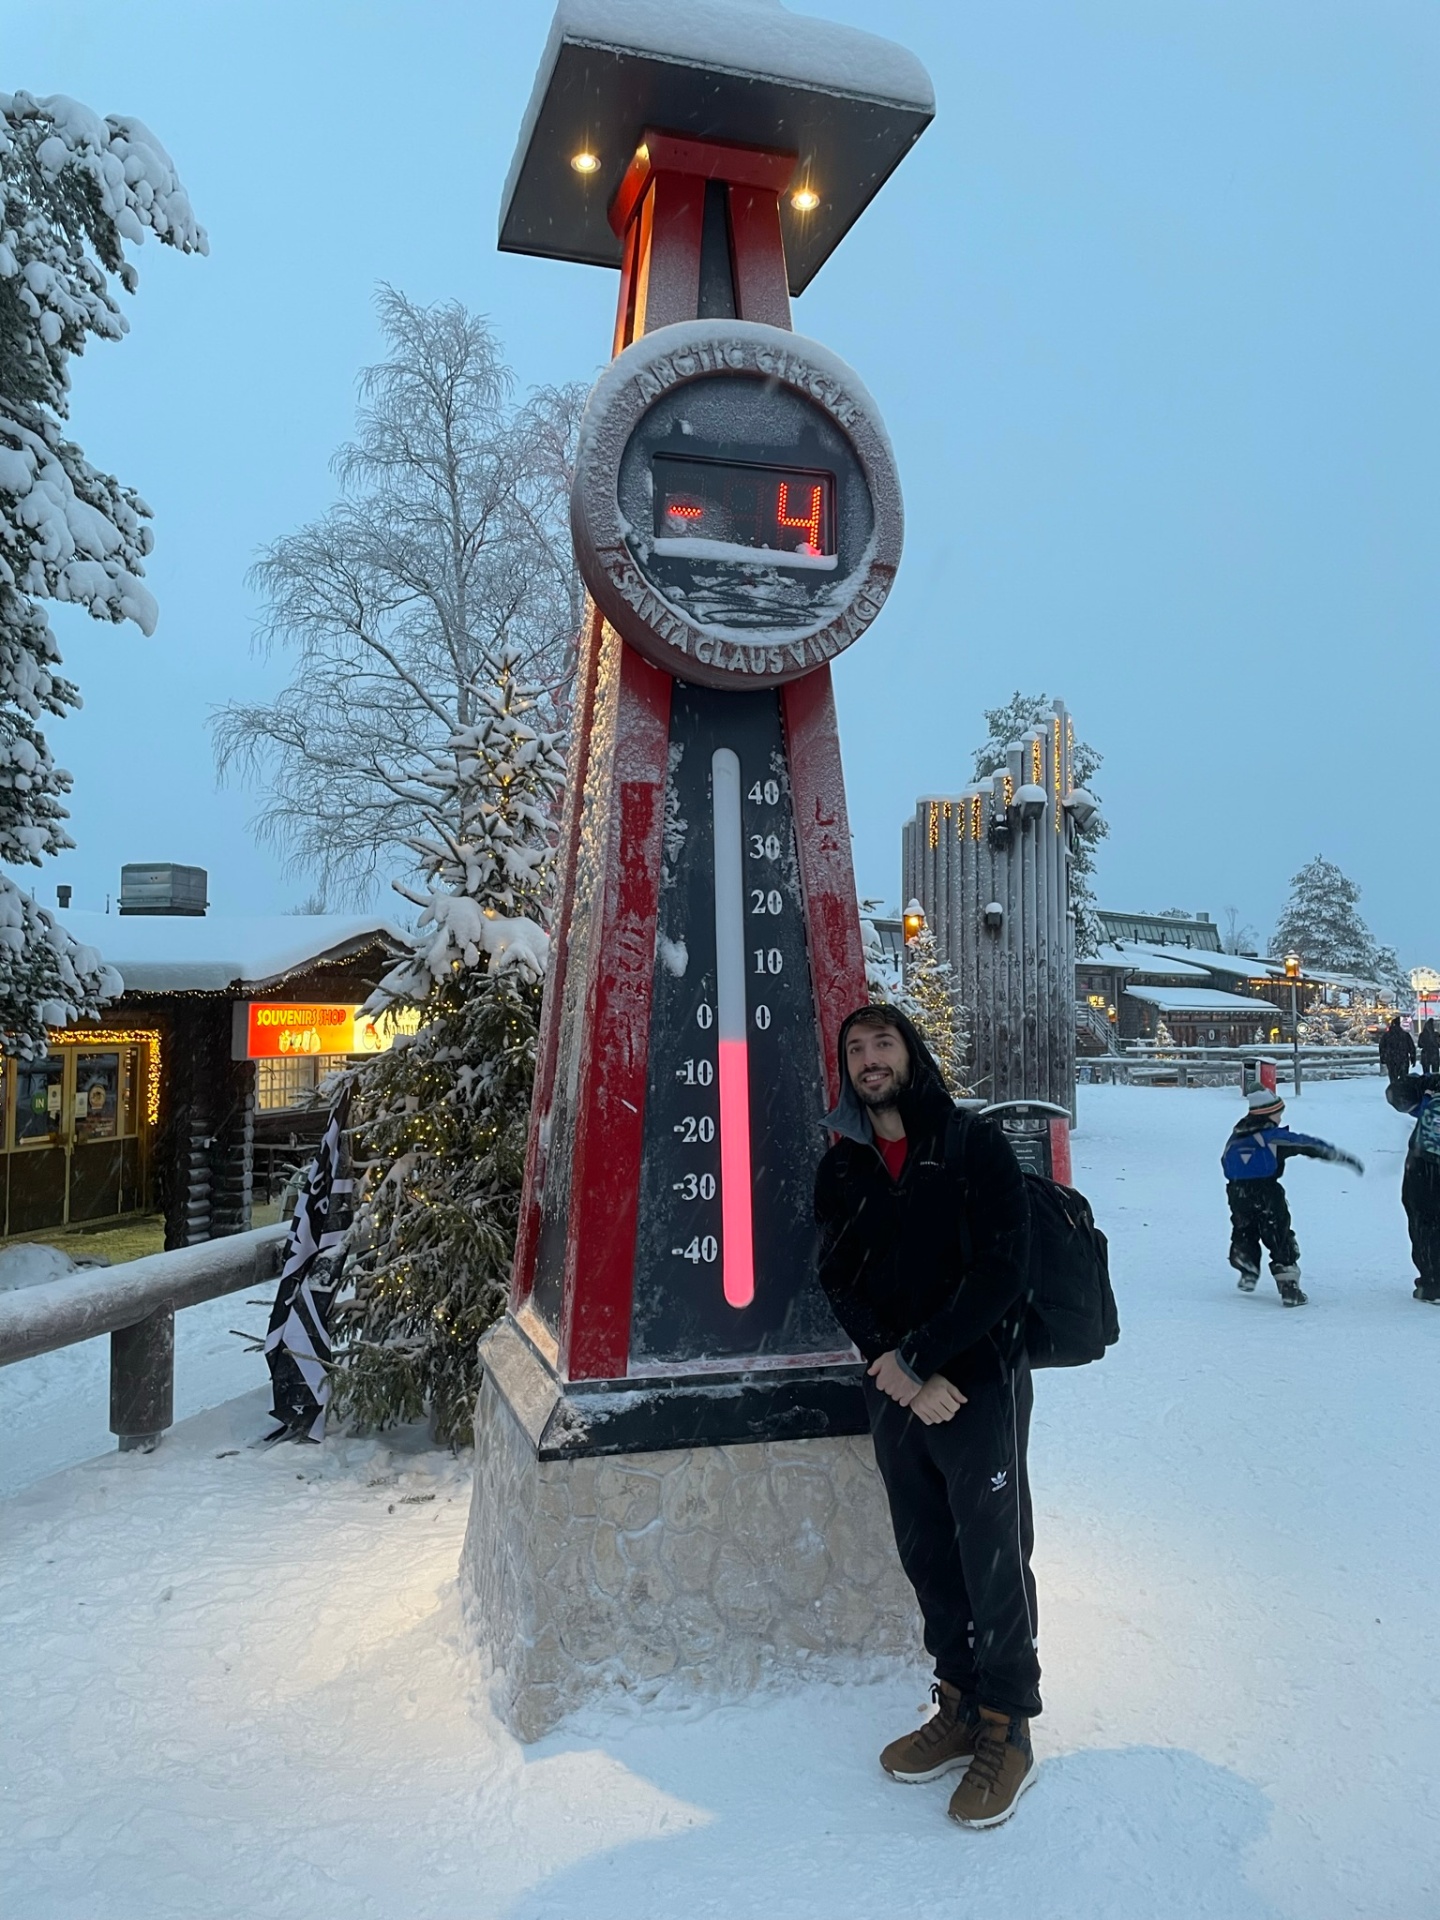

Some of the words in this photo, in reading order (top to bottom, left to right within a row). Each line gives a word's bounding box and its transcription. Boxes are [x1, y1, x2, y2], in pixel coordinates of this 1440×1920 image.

[635, 340, 746, 405] ARCTIC
[611, 569, 688, 653] SANTA
[694, 639, 785, 675] CLAUS
[788, 587, 887, 669] VILLAGE
[747, 780, 780, 806] 40
[749, 834, 781, 861] 30
[750, 889, 783, 915] 20
[753, 948, 783, 975] 10
[257, 1008, 317, 1026] SOUVENIRS
[318, 1008, 347, 1026] SHOP
[696, 1003, 713, 1029] 0
[755, 1004, 771, 1030] 0
[675, 1059, 713, 1086] -10
[35, 1098, 45, 1109] IN
[674, 1115, 715, 1143] -20
[672, 1173, 716, 1201] -30
[671, 1235, 718, 1264] -40
